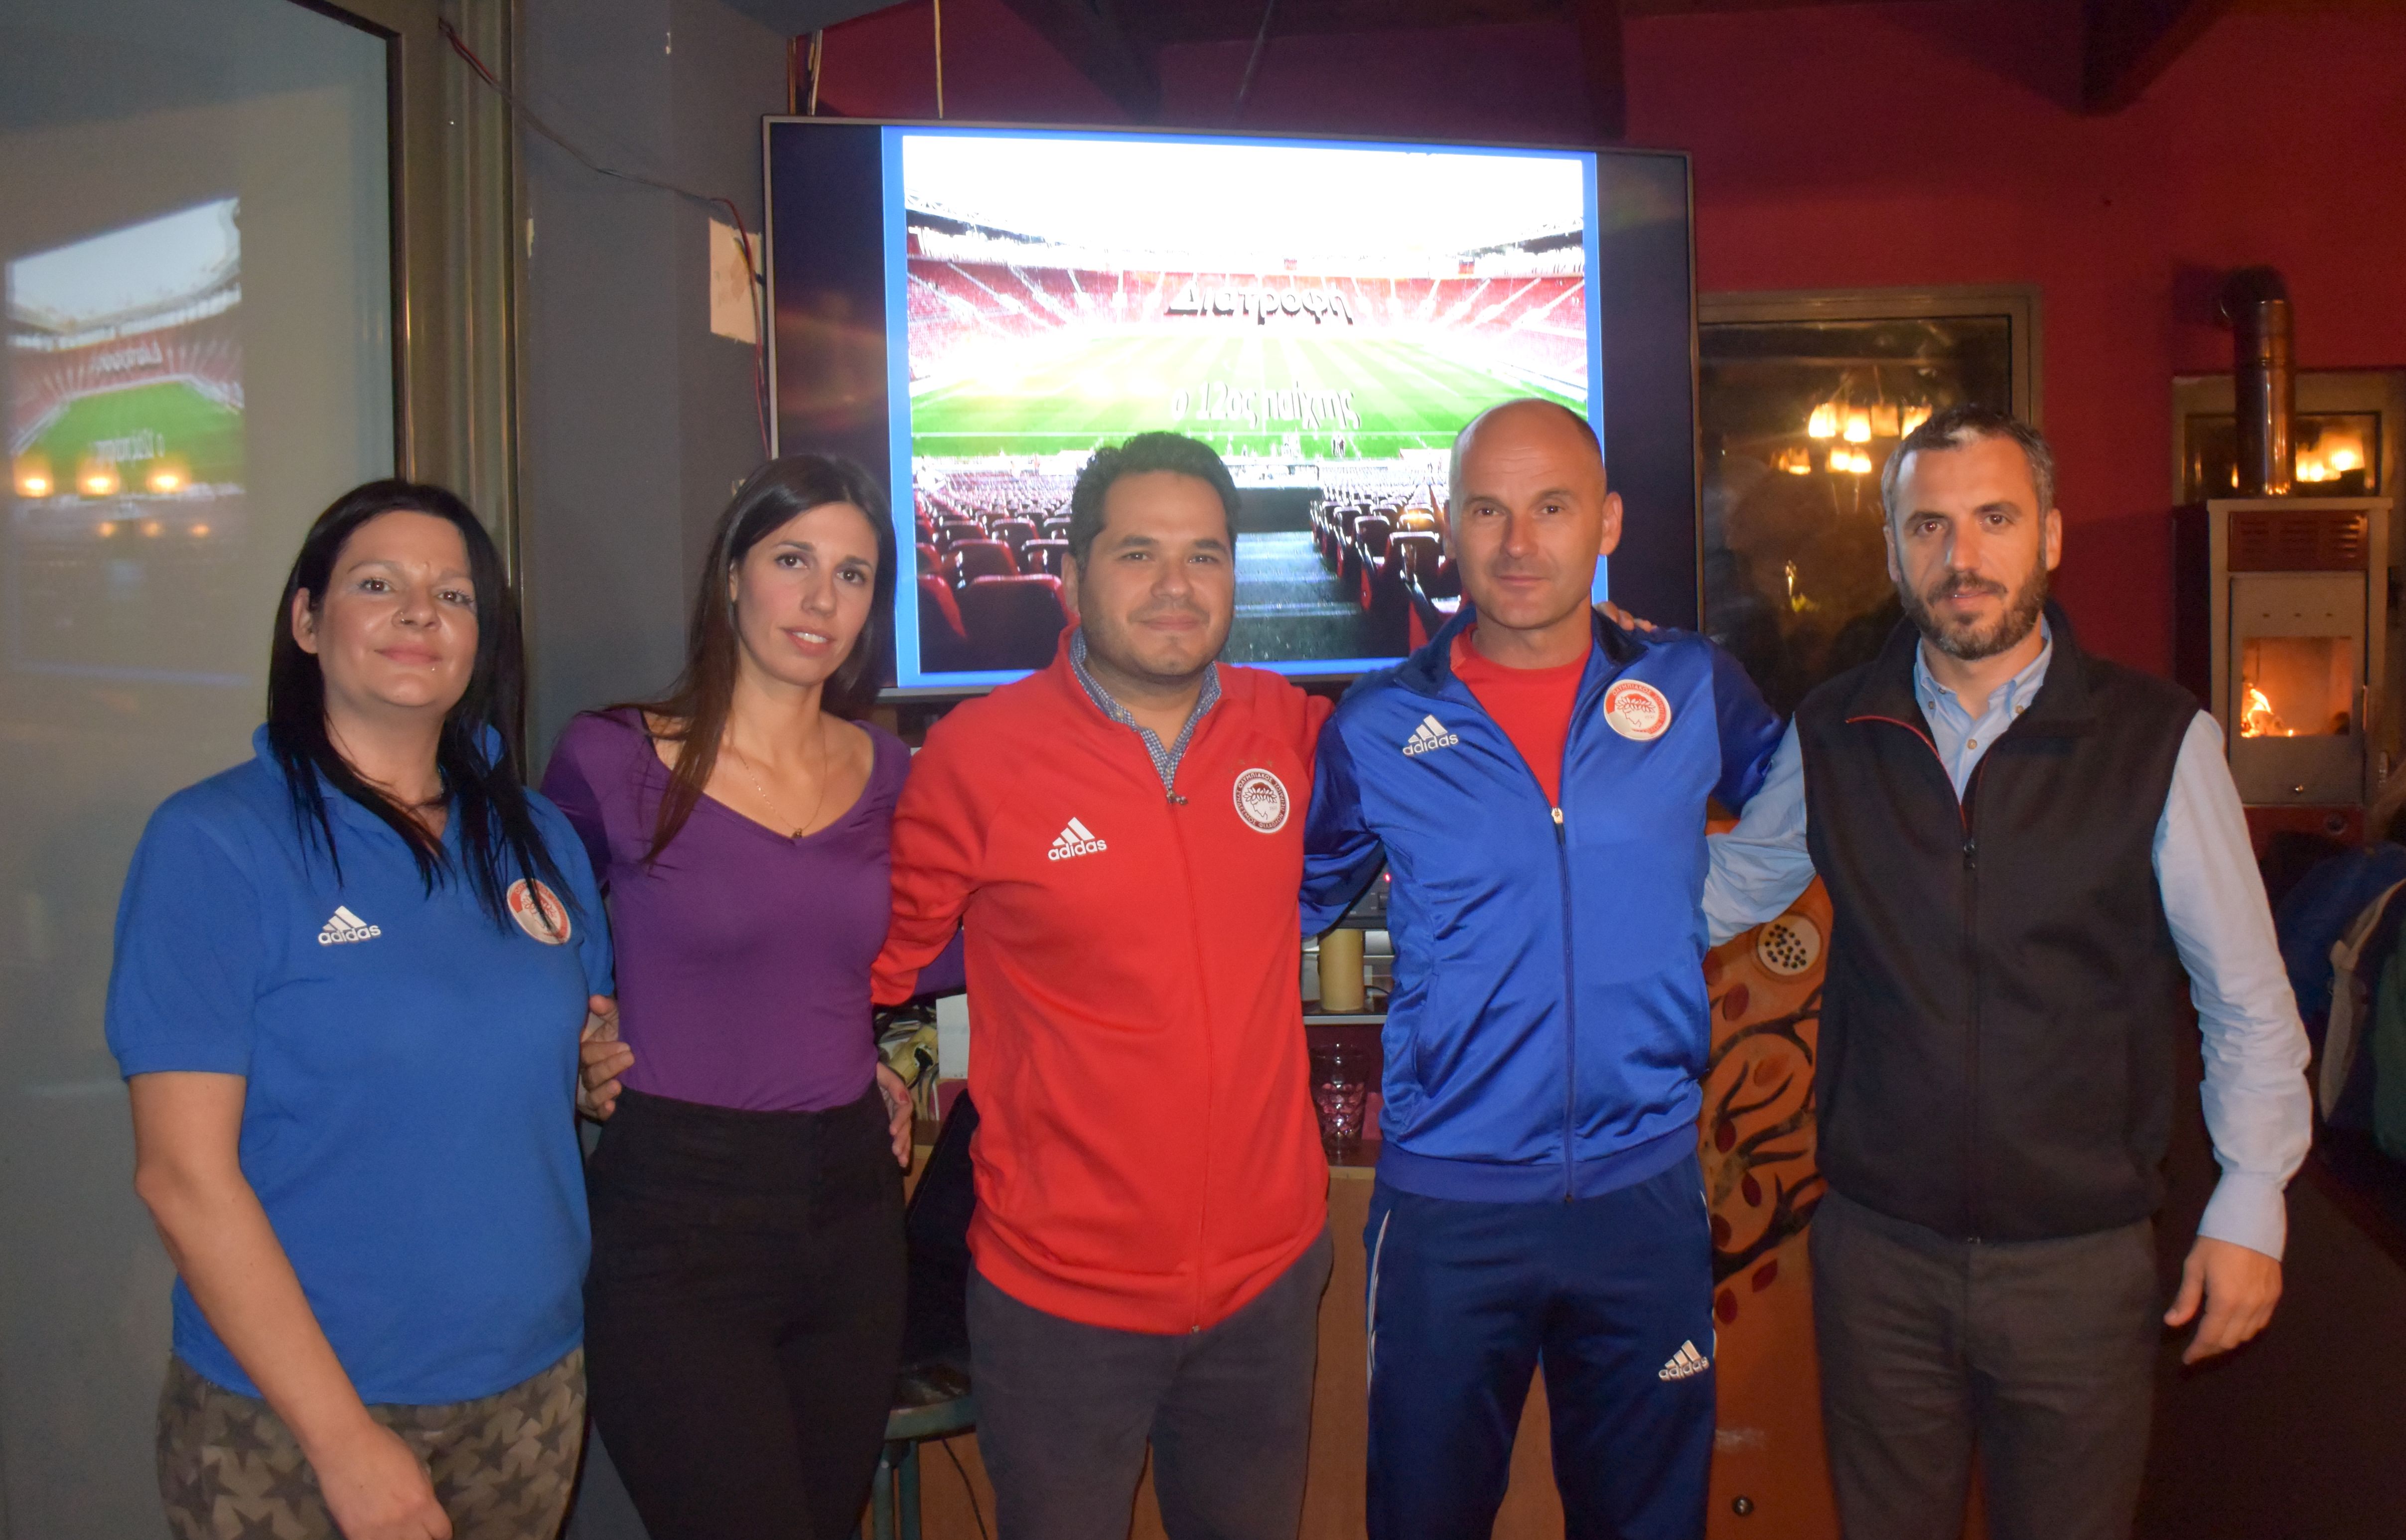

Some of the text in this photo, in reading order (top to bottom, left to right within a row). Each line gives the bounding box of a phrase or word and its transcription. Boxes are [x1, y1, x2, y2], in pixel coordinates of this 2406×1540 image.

[1196, 381, 1258, 429] 12ος
[1403, 734, 1459, 755] adidas
[1238, 772, 1273, 788] ΟΛΥΜΠΙΑΚΟΣ
[1236, 789, 1257, 825] ΣΥΝΔΕΣΜΟΣ
[1048, 839, 1107, 861] adidas
[318, 925, 381, 944] adidas
[1658, 1356, 1710, 1381] adidas
